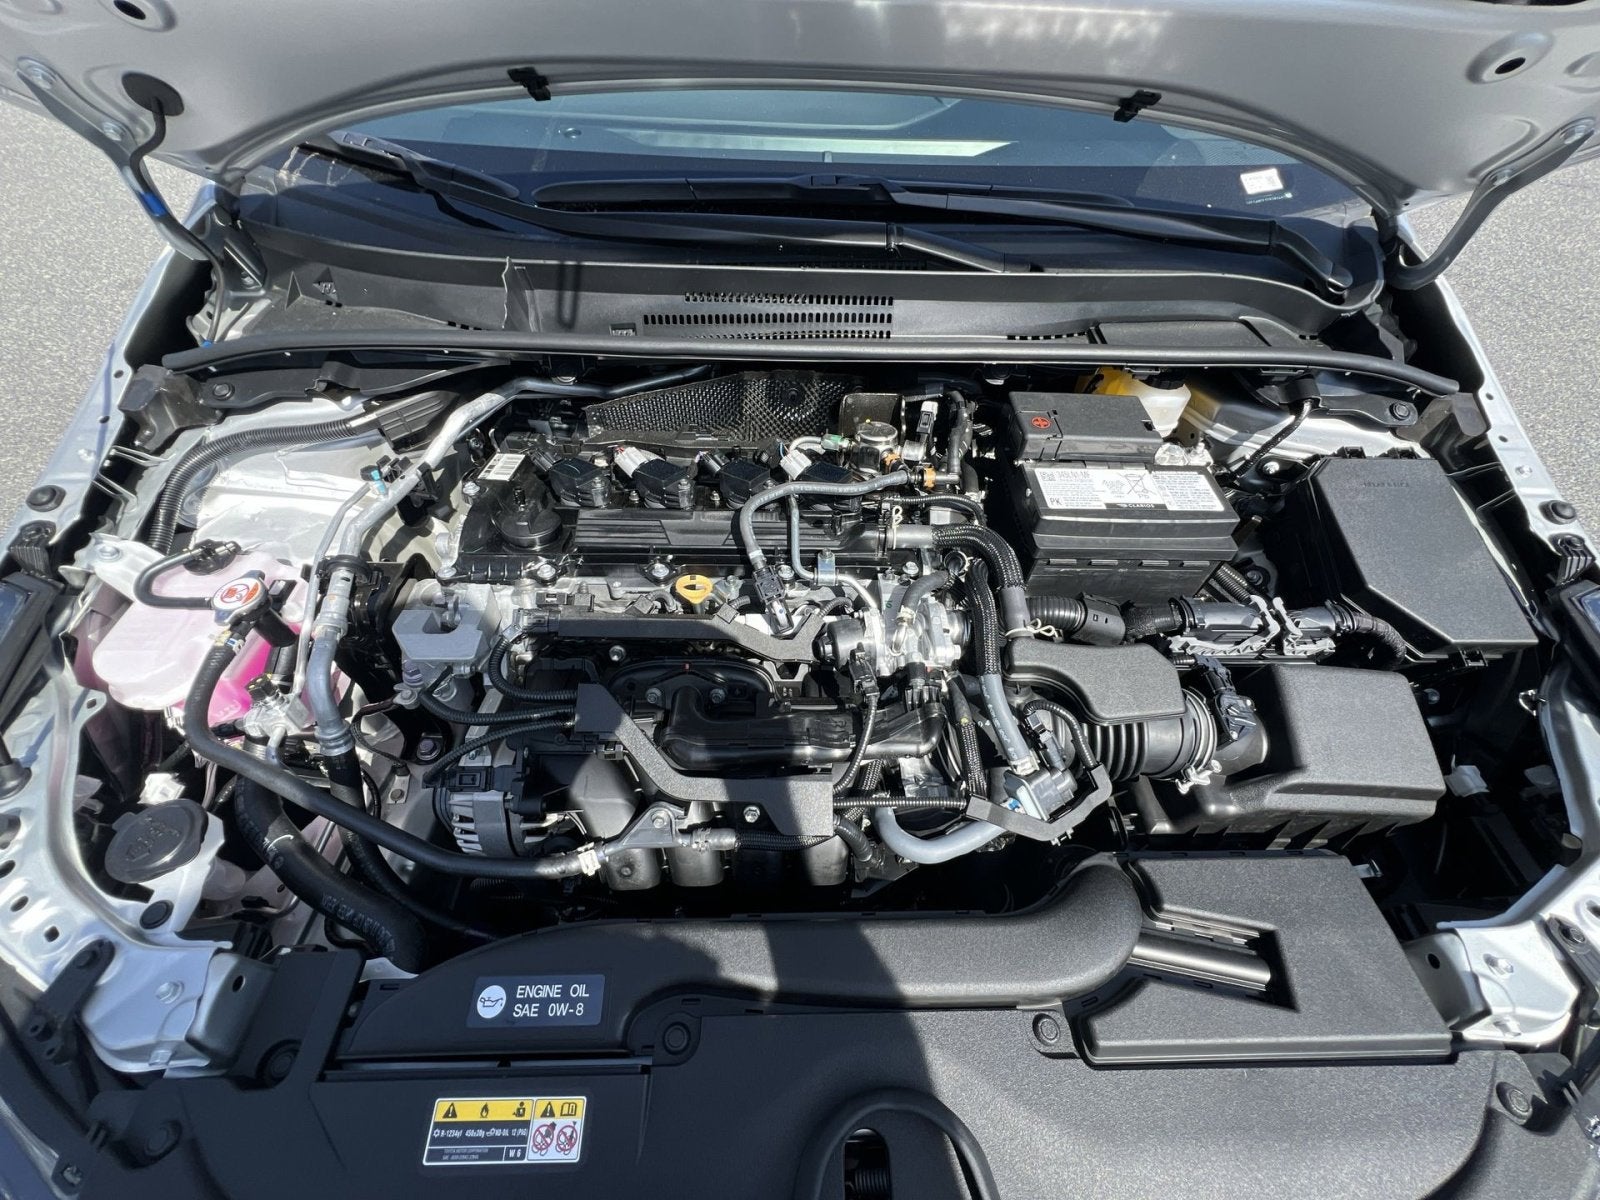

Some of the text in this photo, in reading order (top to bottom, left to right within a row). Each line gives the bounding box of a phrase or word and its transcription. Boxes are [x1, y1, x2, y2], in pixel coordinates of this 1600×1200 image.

[1050, 497, 1062, 505] PK
[516, 984, 590, 998] ENGINE OIL
[513, 1003, 584, 1017] SAE 0W-8
